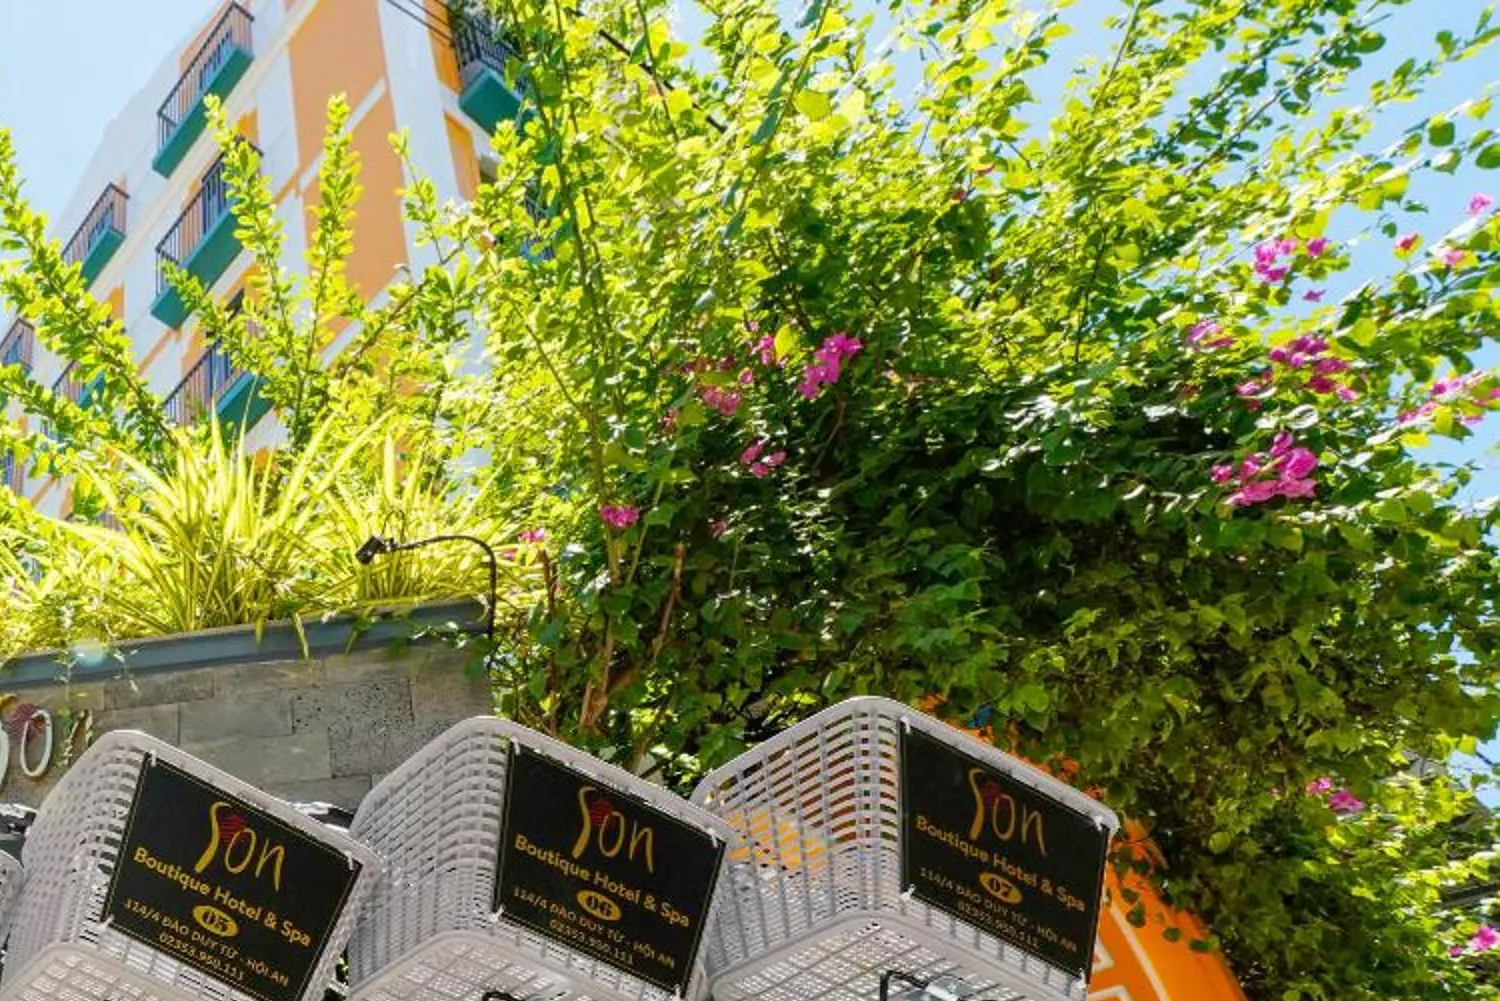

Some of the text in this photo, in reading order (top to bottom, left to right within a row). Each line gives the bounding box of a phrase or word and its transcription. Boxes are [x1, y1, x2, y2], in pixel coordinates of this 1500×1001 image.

[195, 801, 285, 892] Son
[572, 786, 654, 874] Son
[968, 768, 1048, 857] Son
[134, 846, 312, 947] Boutique Hotel & Spa
[515, 834, 690, 929] Boutique Hotel & Spa
[915, 814, 1086, 913] Boutique Hotel & Spa
[191, 931, 218, 950] DUY
